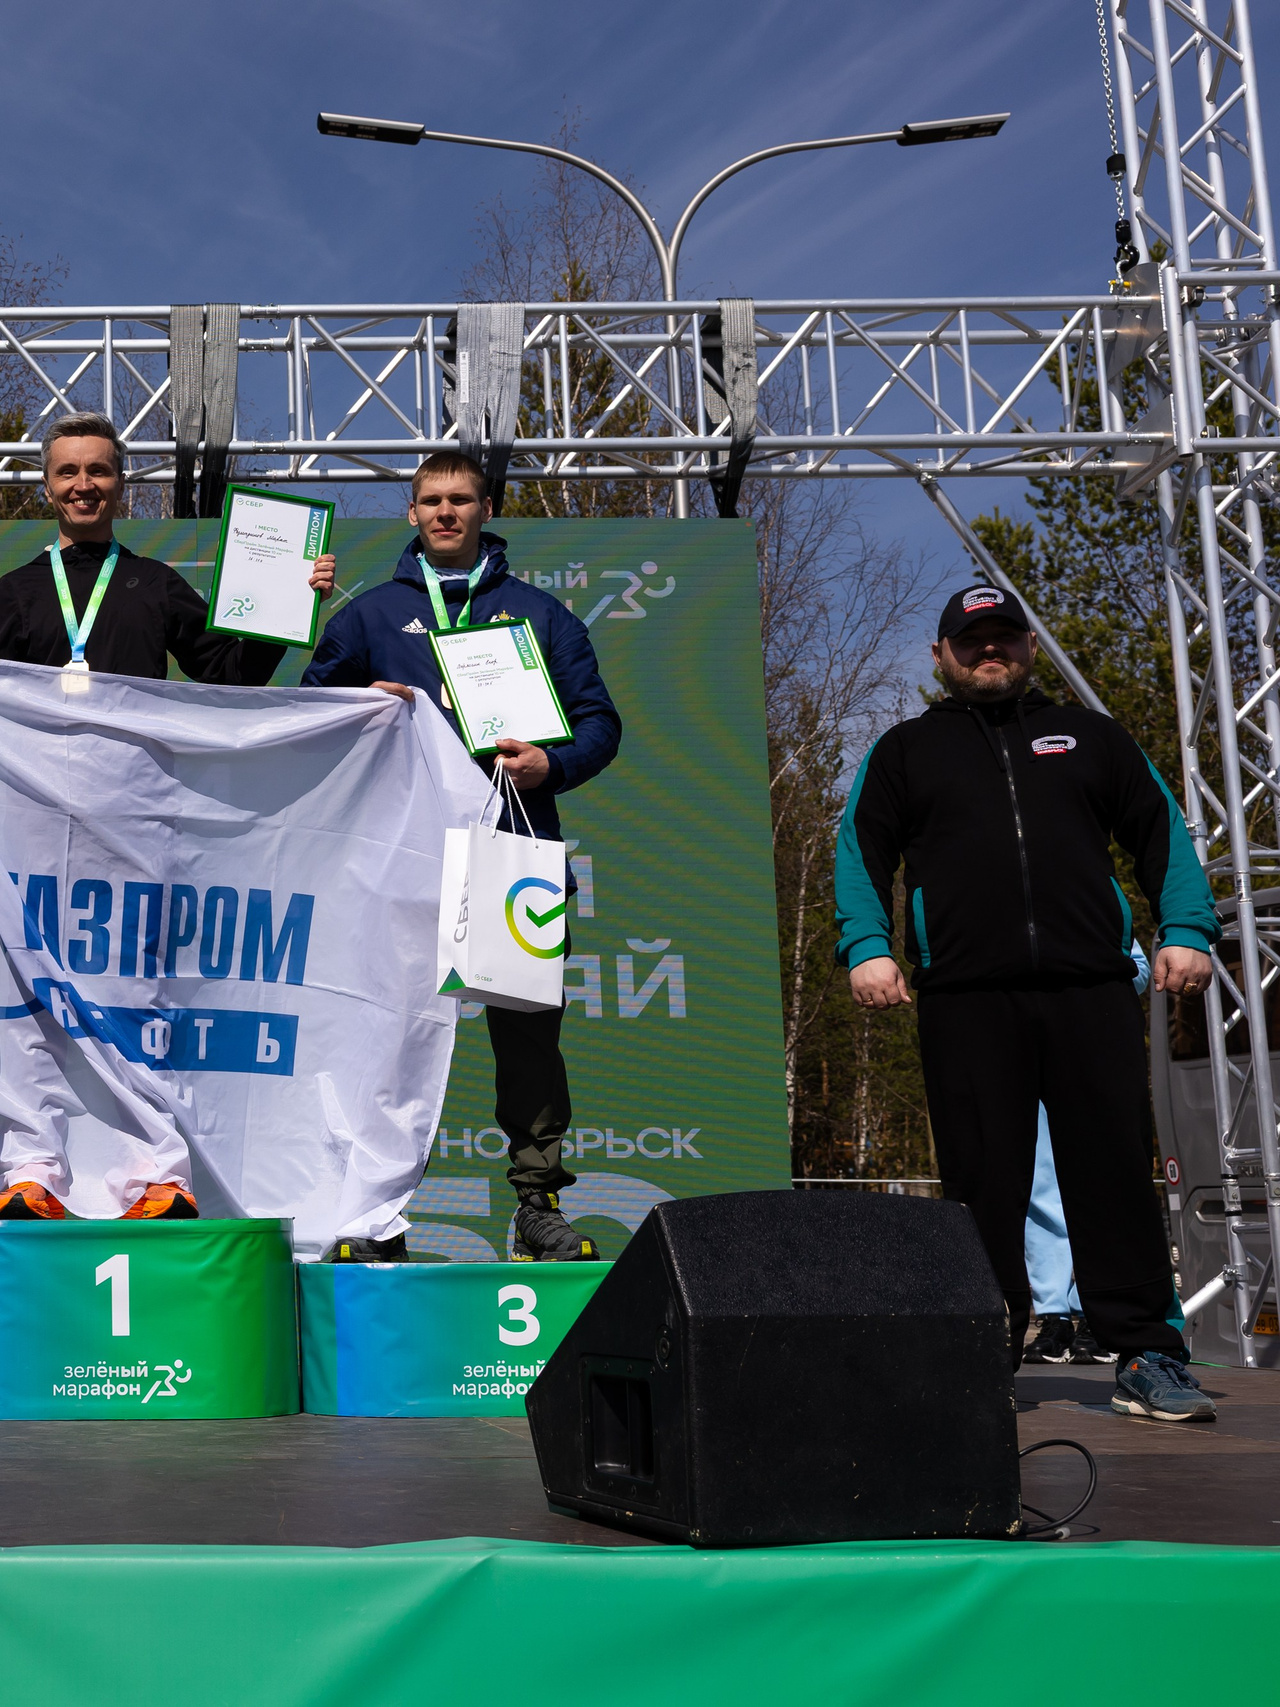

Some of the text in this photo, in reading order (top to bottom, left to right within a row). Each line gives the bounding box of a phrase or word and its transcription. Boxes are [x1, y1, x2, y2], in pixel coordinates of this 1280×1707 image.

[245, 500, 264, 508] СБЕР
[258, 525, 279, 533] МЕСТО
[307, 511, 322, 558] ДИПЛОМ
[450, 637, 467, 645] СБЕР
[513, 628, 535, 667] ДИПЛОМ
[8, 872, 316, 986] АЗПРОМ
[439, 1127, 704, 1159] НОБРЬСК
[95, 1253, 130, 1336] 1
[497, 1283, 541, 1346] 3
[63, 1359, 148, 1378] зелёный
[53, 1379, 141, 1400] марафон
